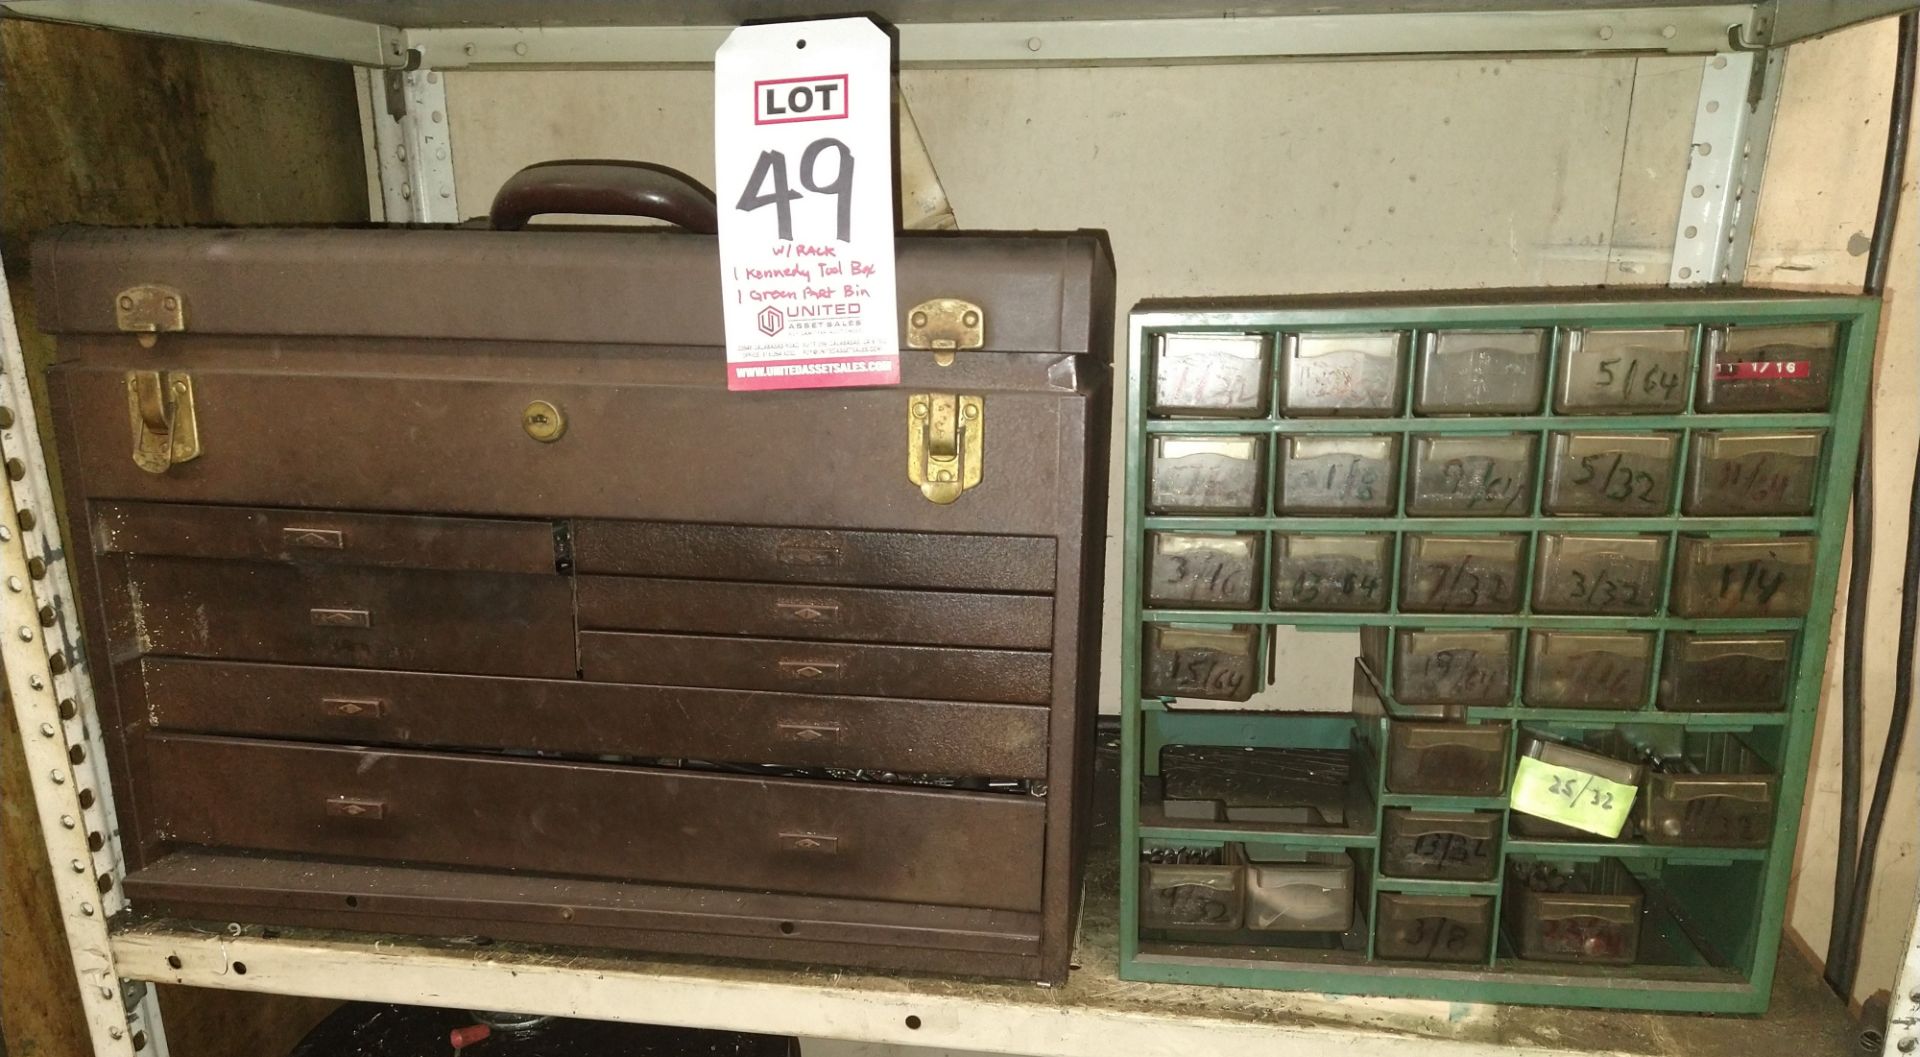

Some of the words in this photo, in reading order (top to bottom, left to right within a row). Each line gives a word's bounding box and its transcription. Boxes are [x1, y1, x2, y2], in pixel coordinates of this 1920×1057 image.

[766, 84, 838, 115] LOT
[735, 137, 855, 243] 49
[818, 261, 843, 277] Tool
[851, 260, 876, 278] Box
[843, 284, 871, 298] Bin
[787, 303, 861, 317] UNITED
[736, 360, 893, 378] WWW.UNITEDASSETSALES.COM
[1596, 357, 1678, 401] 5/64
[1752, 362, 1796, 373] 1/16
[1573, 454, 1655, 503] 5/32
[1548, 775, 1614, 809] 25/32
